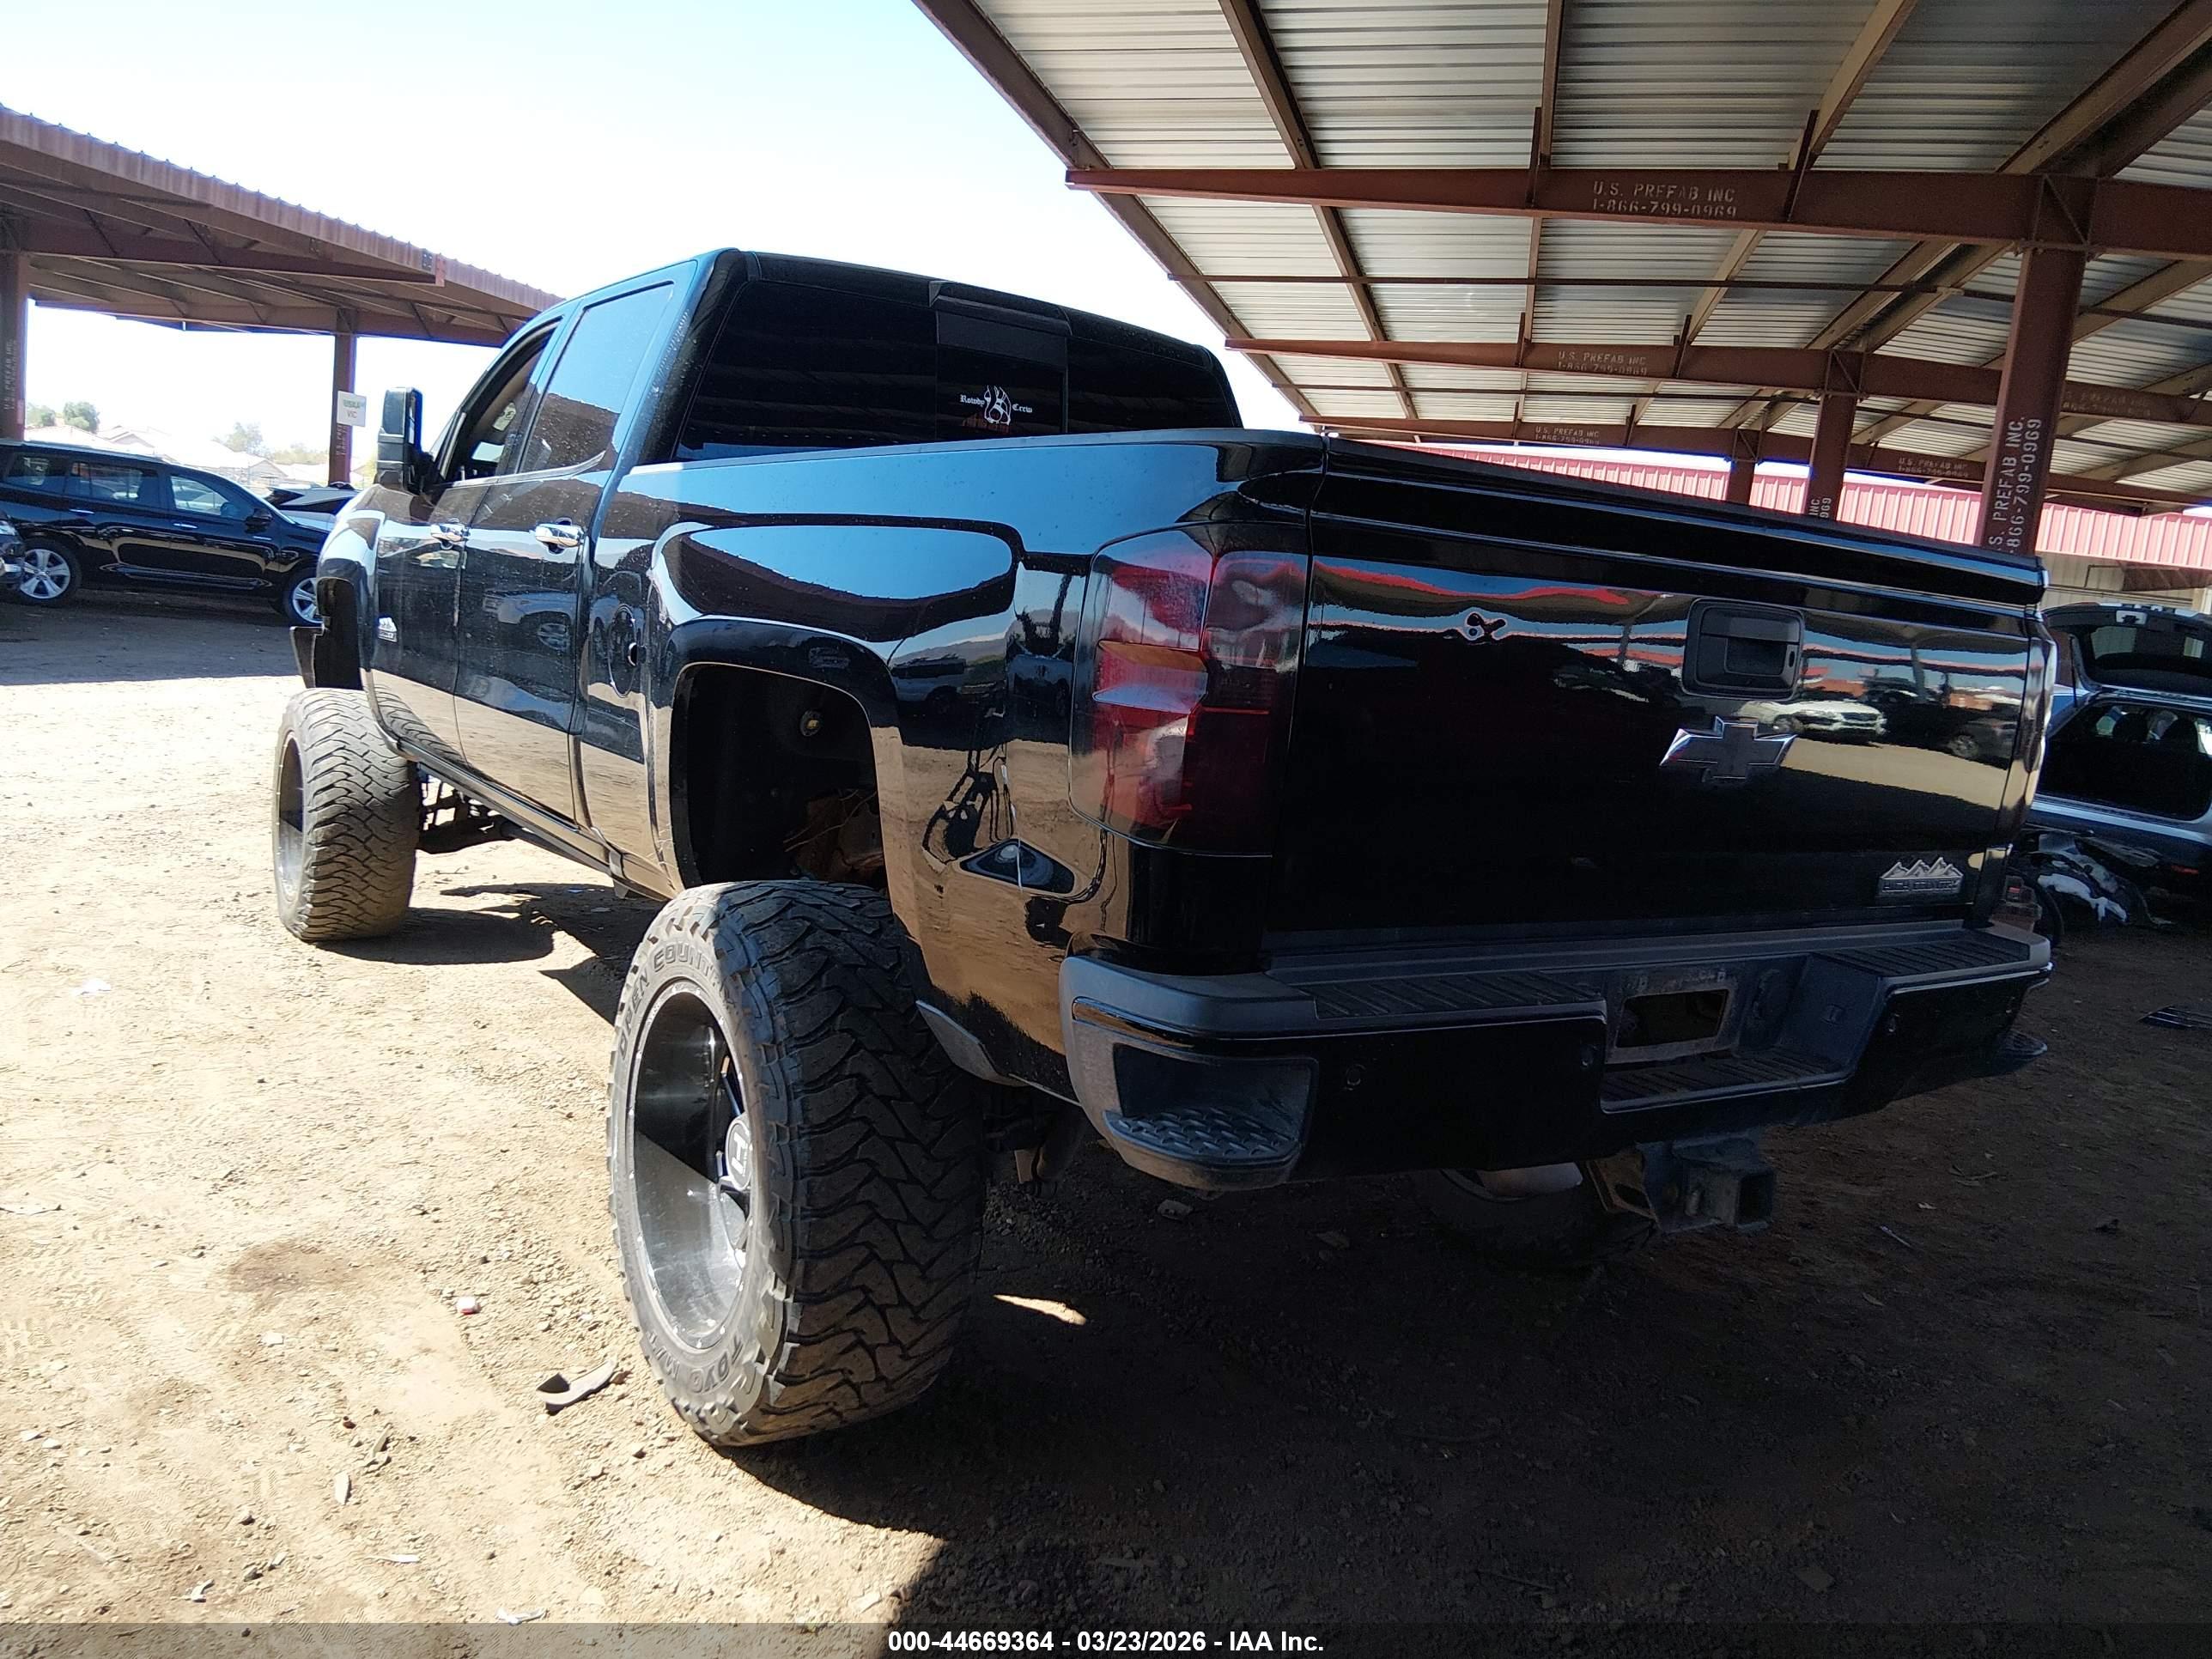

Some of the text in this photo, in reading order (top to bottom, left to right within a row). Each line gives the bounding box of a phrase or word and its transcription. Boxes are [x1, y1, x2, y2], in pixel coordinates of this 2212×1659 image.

[1592, 198, 1738, 218] 1-866-799-0969
[1593, 180, 1735, 203] U.S. PREFAB INC
[960, 394, 1033, 413] Rowdy Crew
[1992, 456, 2018, 521] PREFAB
[2005, 416, 2025, 447] INC.
[2006, 418, 2042, 555] -866-799-0969
[619, 969, 650, 1060] OPEN
[689, 1333, 744, 1395] TOYO
